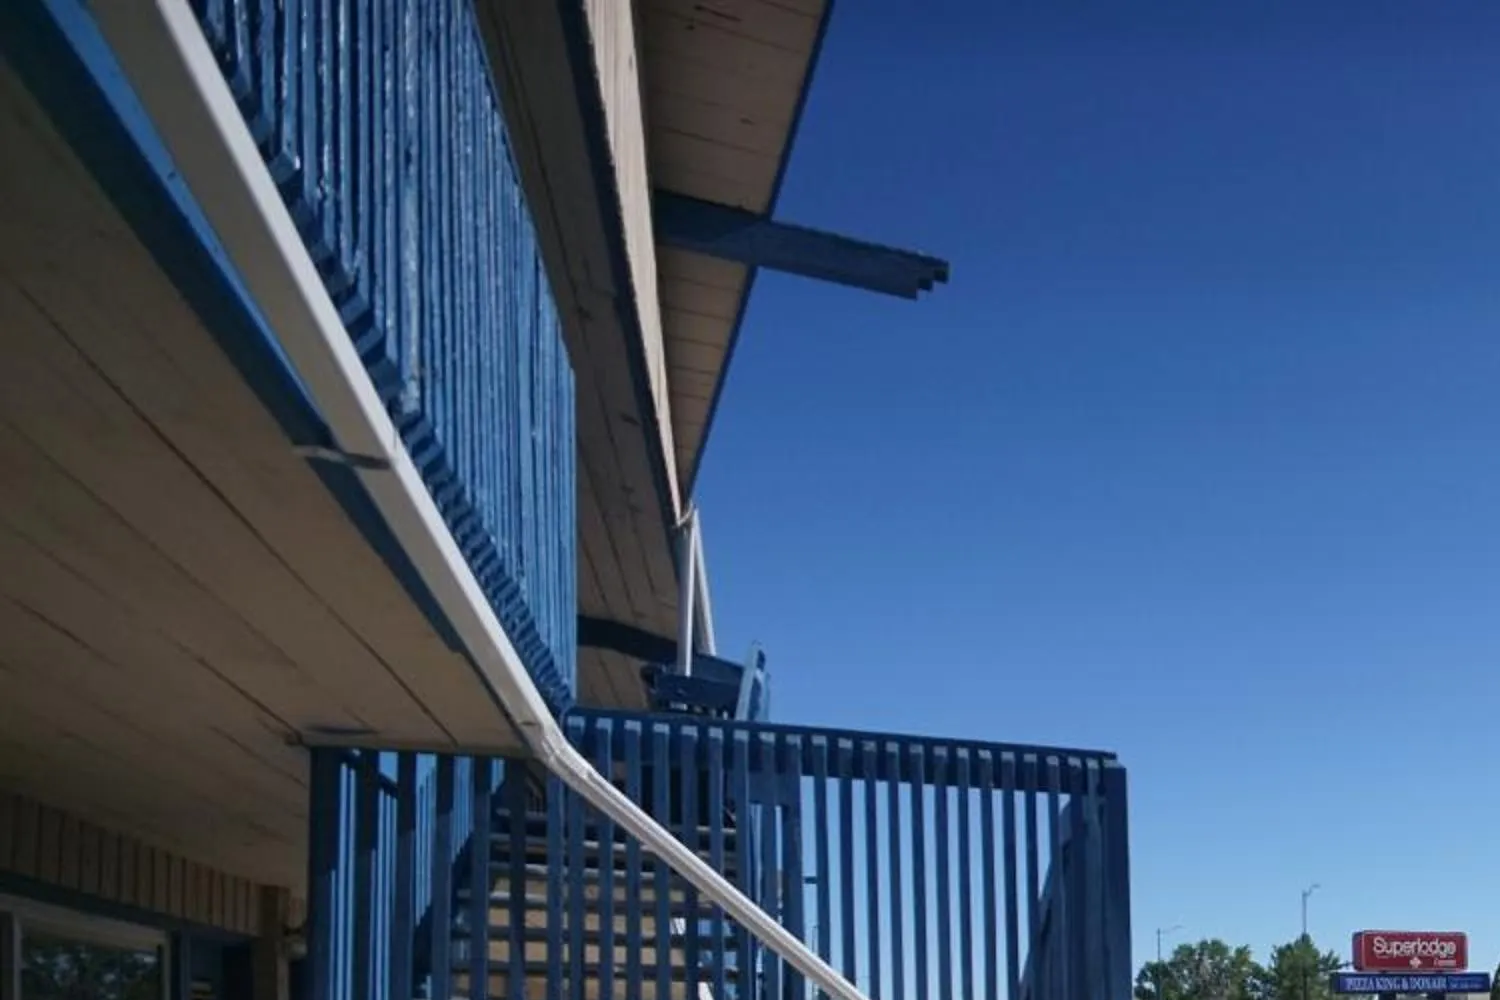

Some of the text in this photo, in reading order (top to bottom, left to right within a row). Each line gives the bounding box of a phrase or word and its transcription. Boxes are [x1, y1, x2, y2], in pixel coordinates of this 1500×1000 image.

[1373, 936, 1457, 958] Superlodge
[1345, 977, 1375, 991] PIZZA
[1375, 977, 1400, 991] KING
